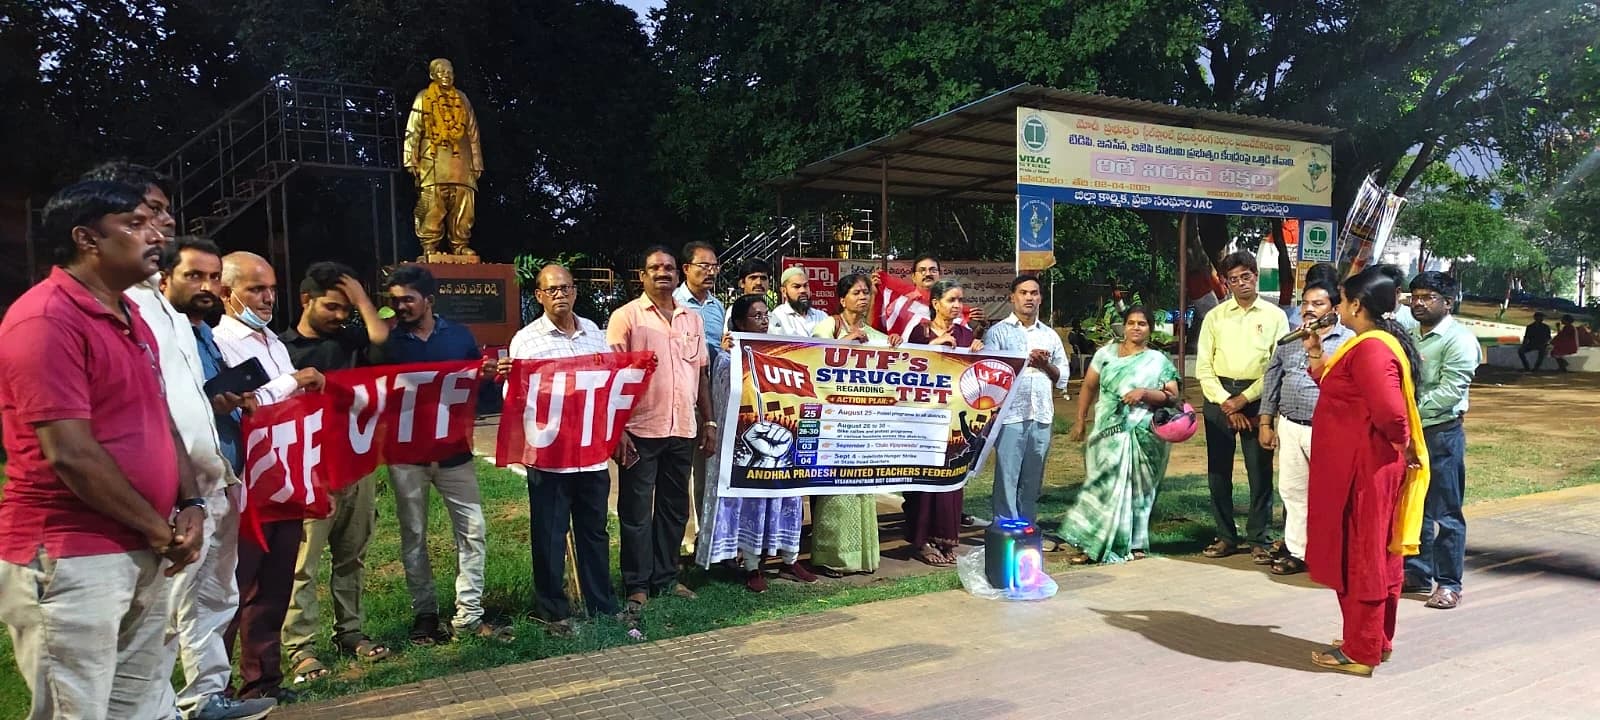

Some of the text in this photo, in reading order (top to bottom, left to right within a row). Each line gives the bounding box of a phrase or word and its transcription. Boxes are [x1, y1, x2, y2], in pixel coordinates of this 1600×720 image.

[1019, 155, 1051, 164] VIZAG
[1155, 144, 1185, 156] కూటమి
[1187, 148, 1219, 161] ప్రభుత్వం
[1096, 157, 1274, 190] రిలే నిరసన దీక్షలు
[1074, 190, 1096, 205] జిల్లా
[1131, 194, 1152, 208] ప్రజా
[1192, 200, 1213, 209] JAC
[1241, 202, 1290, 216] విశాఖపట్నం
[824, 347, 928, 373] UTF's
[763, 364, 805, 390] UTF
[816, 368, 951, 389] STRUGGLE
[978, 368, 1010, 386] UTF
[836, 385, 884, 394] REGARDING
[896, 386, 953, 404] TET
[523, 368, 646, 449] UTF
[837, 396, 868, 404] ACTION
[349, 367, 477, 455] UTF
[804, 410, 816, 418] 25
[838, 408, 863, 416] August
[801, 457, 811, 465] 04
[746, 469, 790, 481] ANDHRA
[793, 468, 837, 479] PRADESH
[839, 467, 873, 478] UNITED
[875, 467, 920, 477] TEACHERS
